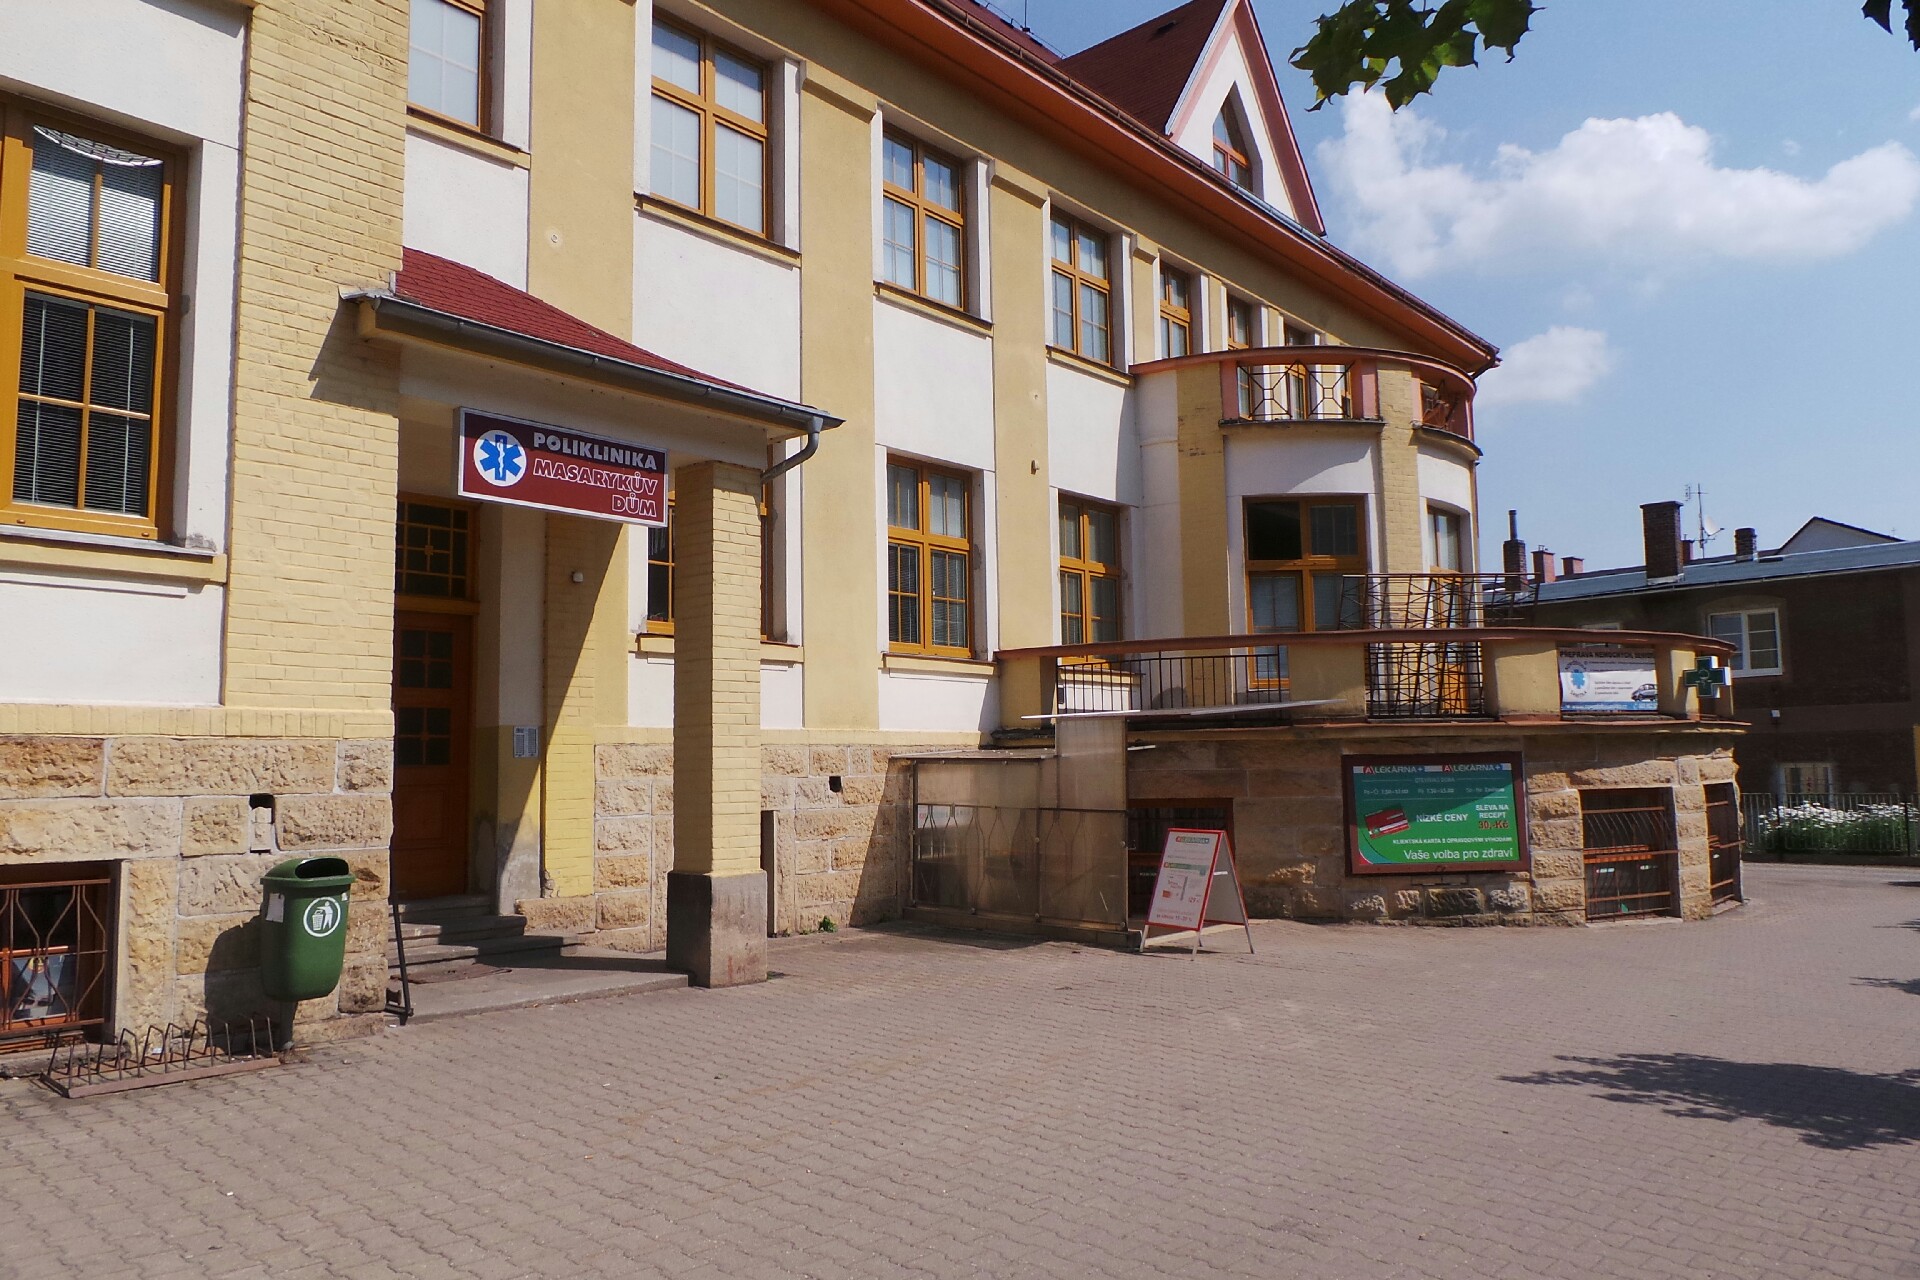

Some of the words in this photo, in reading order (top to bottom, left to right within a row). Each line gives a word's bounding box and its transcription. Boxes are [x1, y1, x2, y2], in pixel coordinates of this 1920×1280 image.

[533, 432, 658, 471] POLIKLINIKA
[533, 458, 658, 496] MASARYKŮV
[612, 492, 657, 518] DŮM
[1415, 813, 1442, 823] NÍZKÉ
[1444, 813, 1468, 822] CENY
[1479, 811, 1506, 819] RECEPT
[1404, 849, 1430, 860] Vaše
[1433, 849, 1460, 860] volba
[1462, 851, 1480, 861] pro
[1482, 847, 1513, 859] zdraví
